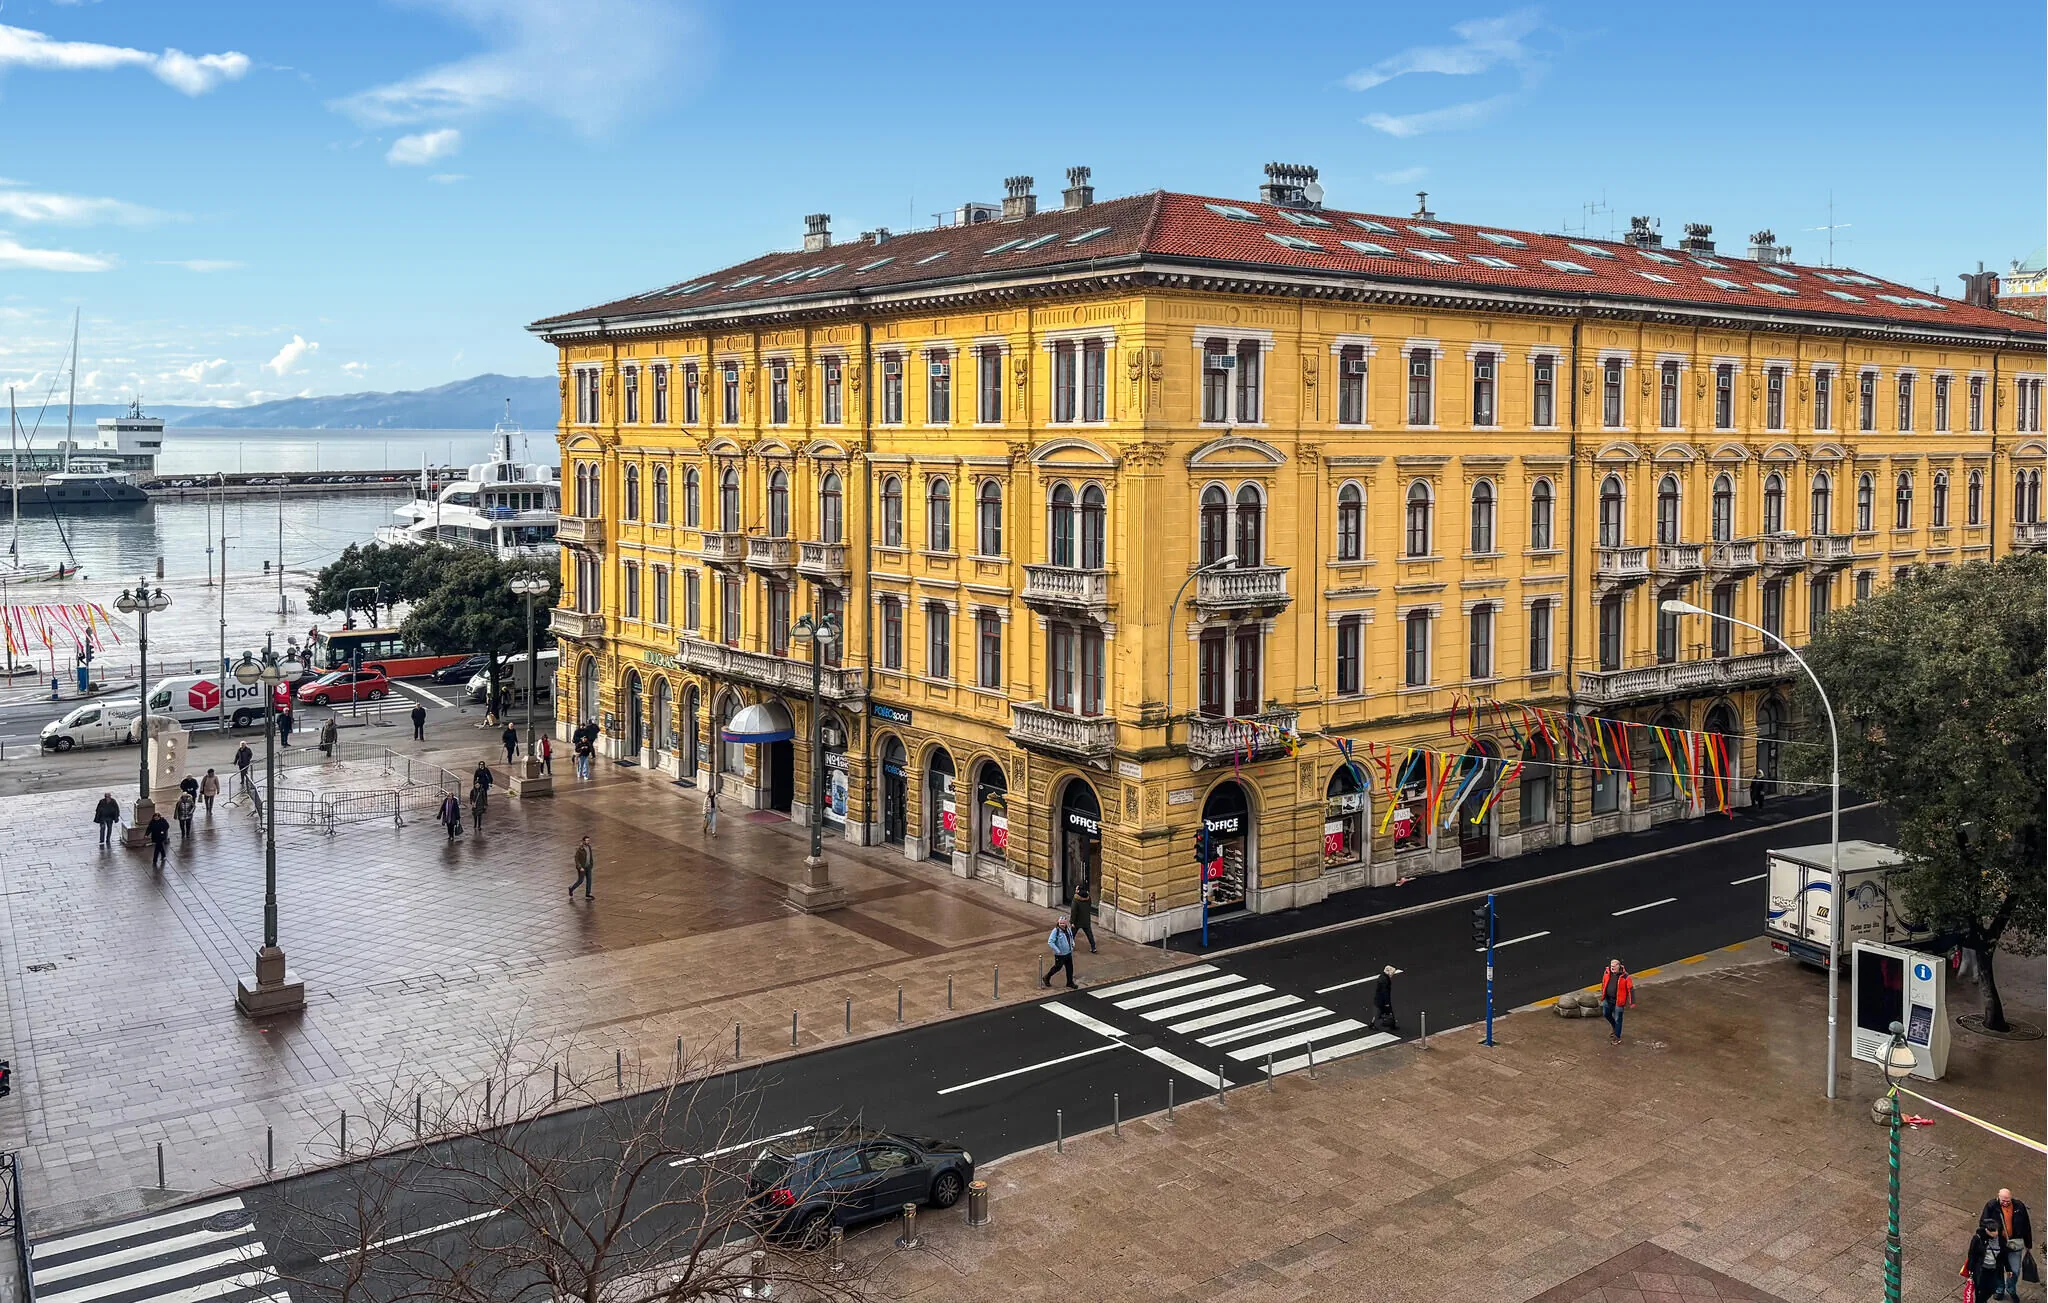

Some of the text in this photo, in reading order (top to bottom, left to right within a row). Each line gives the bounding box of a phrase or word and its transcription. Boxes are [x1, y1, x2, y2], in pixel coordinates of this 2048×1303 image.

[226, 683, 258, 701] dpd
[1069, 814, 1098, 830] OFFICE
[1208, 818, 1239, 832] OFFICE
